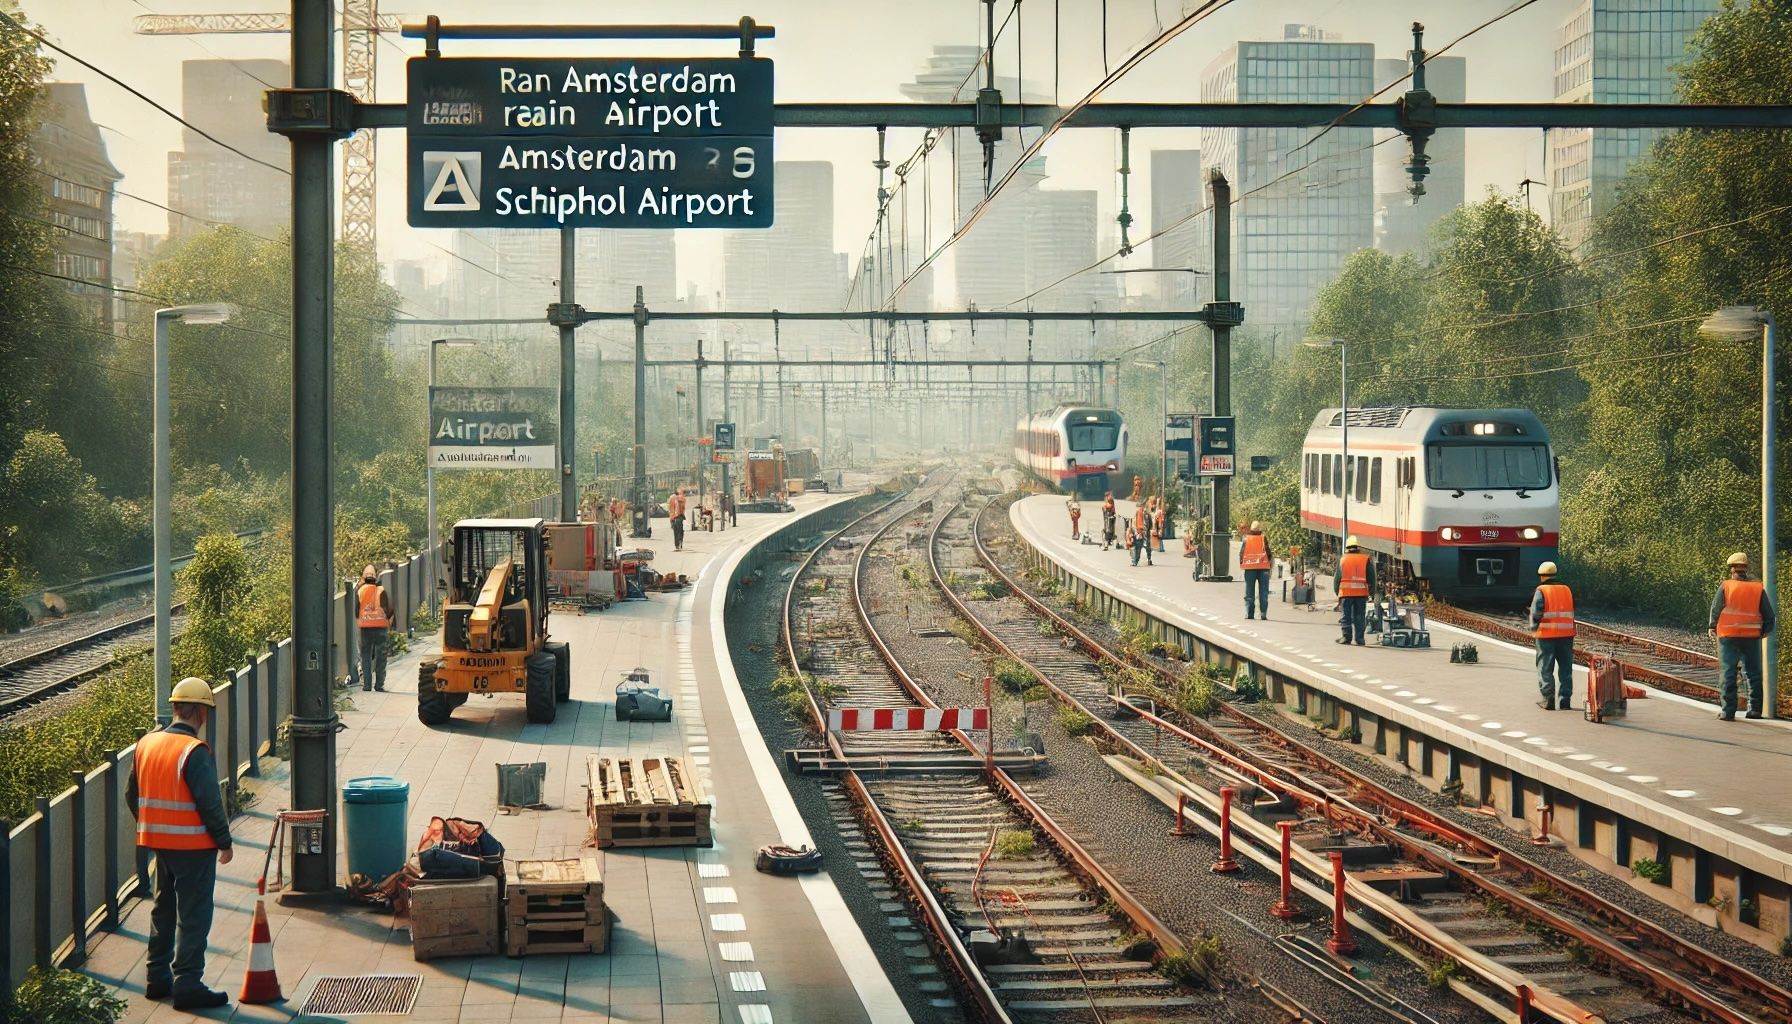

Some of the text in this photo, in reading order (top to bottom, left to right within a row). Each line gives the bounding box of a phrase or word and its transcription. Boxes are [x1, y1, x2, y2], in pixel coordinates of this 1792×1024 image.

[500, 65, 736, 94] Ran Amsterdam
[604, 98, 722, 133] Airport
[498, 144, 676, 172] Amsterdam
[495, 185, 754, 224] Schiphol Airport
[435, 416, 536, 445] Airport
